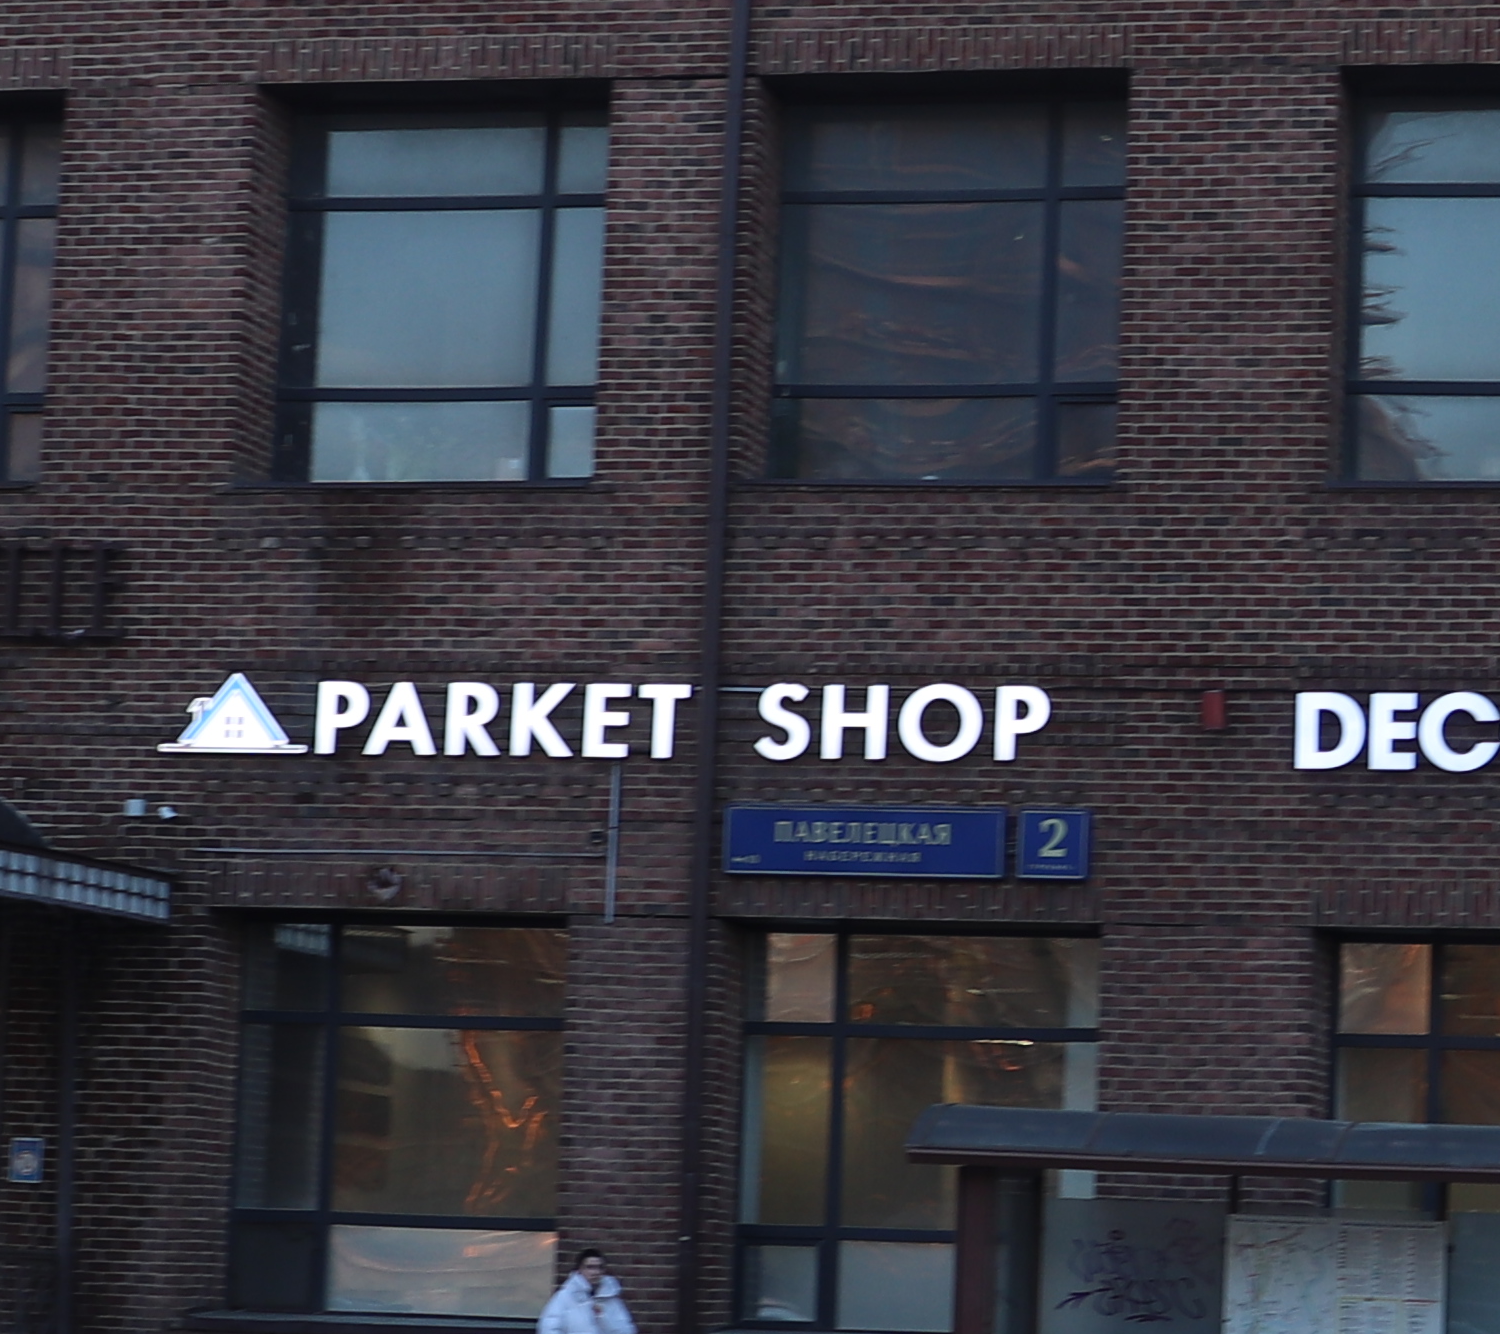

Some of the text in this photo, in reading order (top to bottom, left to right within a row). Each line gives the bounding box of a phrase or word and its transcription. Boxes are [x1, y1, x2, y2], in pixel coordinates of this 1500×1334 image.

[314, 680, 1052, 763] PARKET SHOP
[773, 820, 953, 847] ПАВЕЛЕЦКАЯ
[1037, 817, 1069, 857] 2
